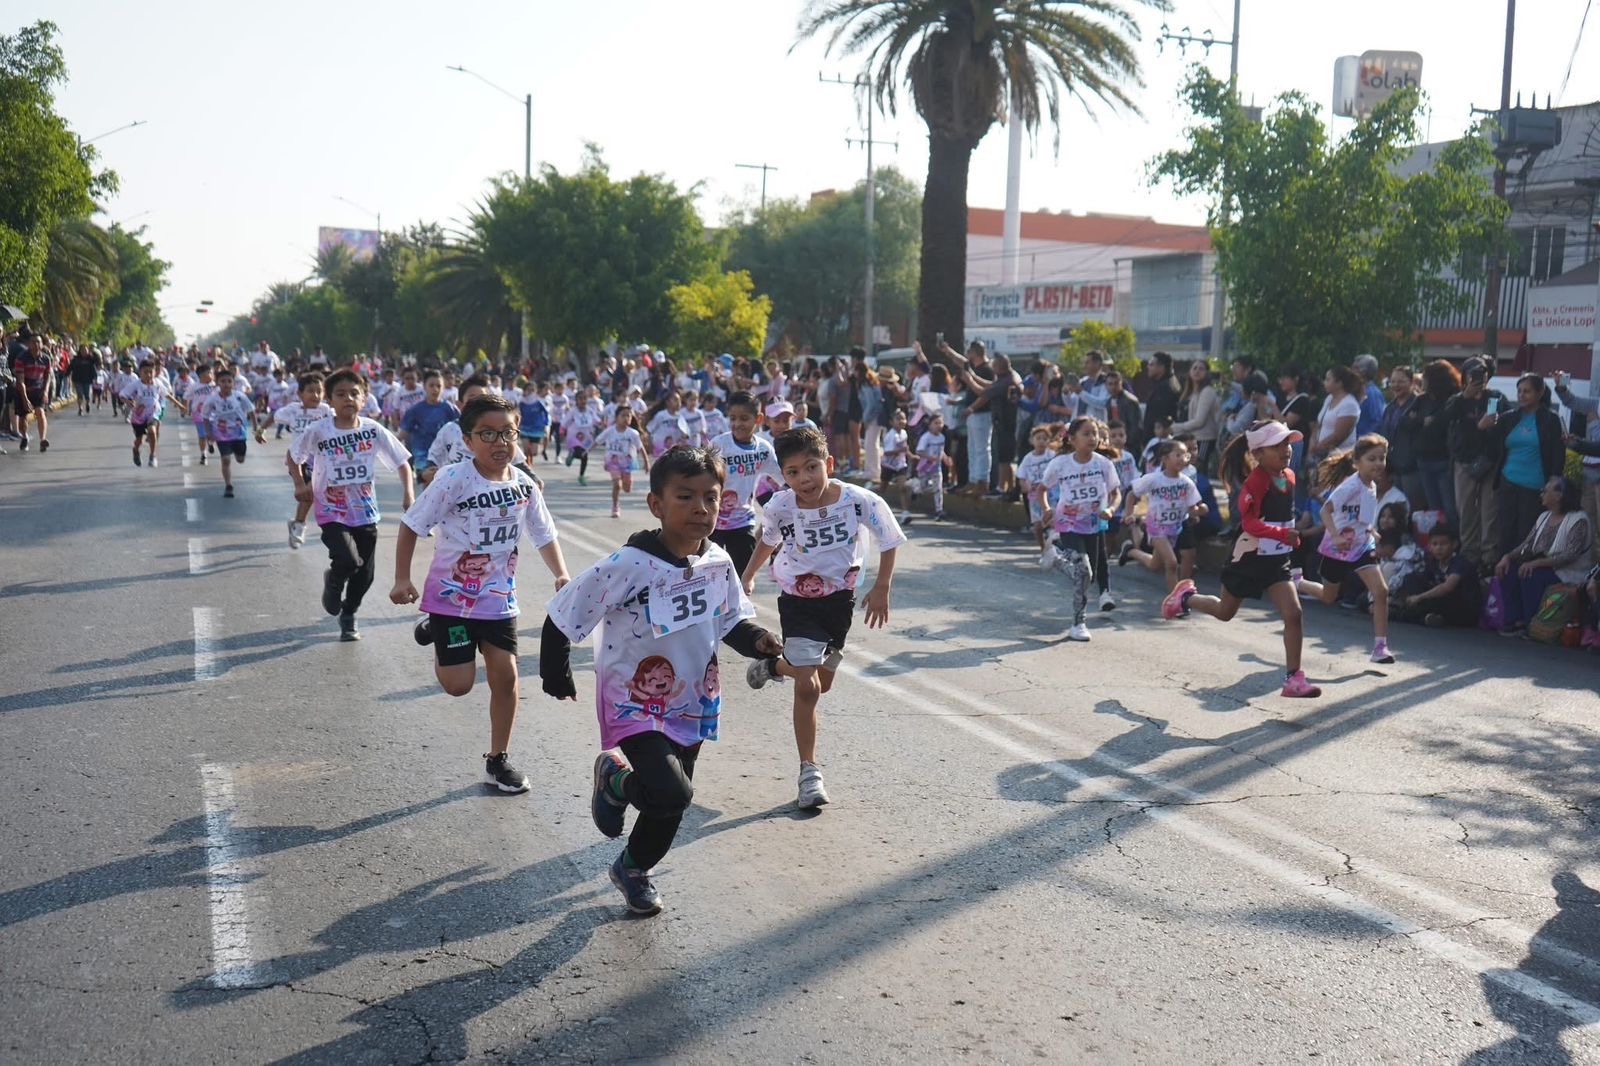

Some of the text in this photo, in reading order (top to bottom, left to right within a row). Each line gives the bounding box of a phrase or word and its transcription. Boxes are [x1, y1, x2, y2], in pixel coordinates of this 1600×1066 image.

[1532, 317, 1543, 328] La
[335, 465, 368, 481] 199
[1071, 487, 1098, 500] 159
[479, 524, 519, 546] 144
[803, 522, 849, 548] 355
[672, 589, 707, 622] 35
